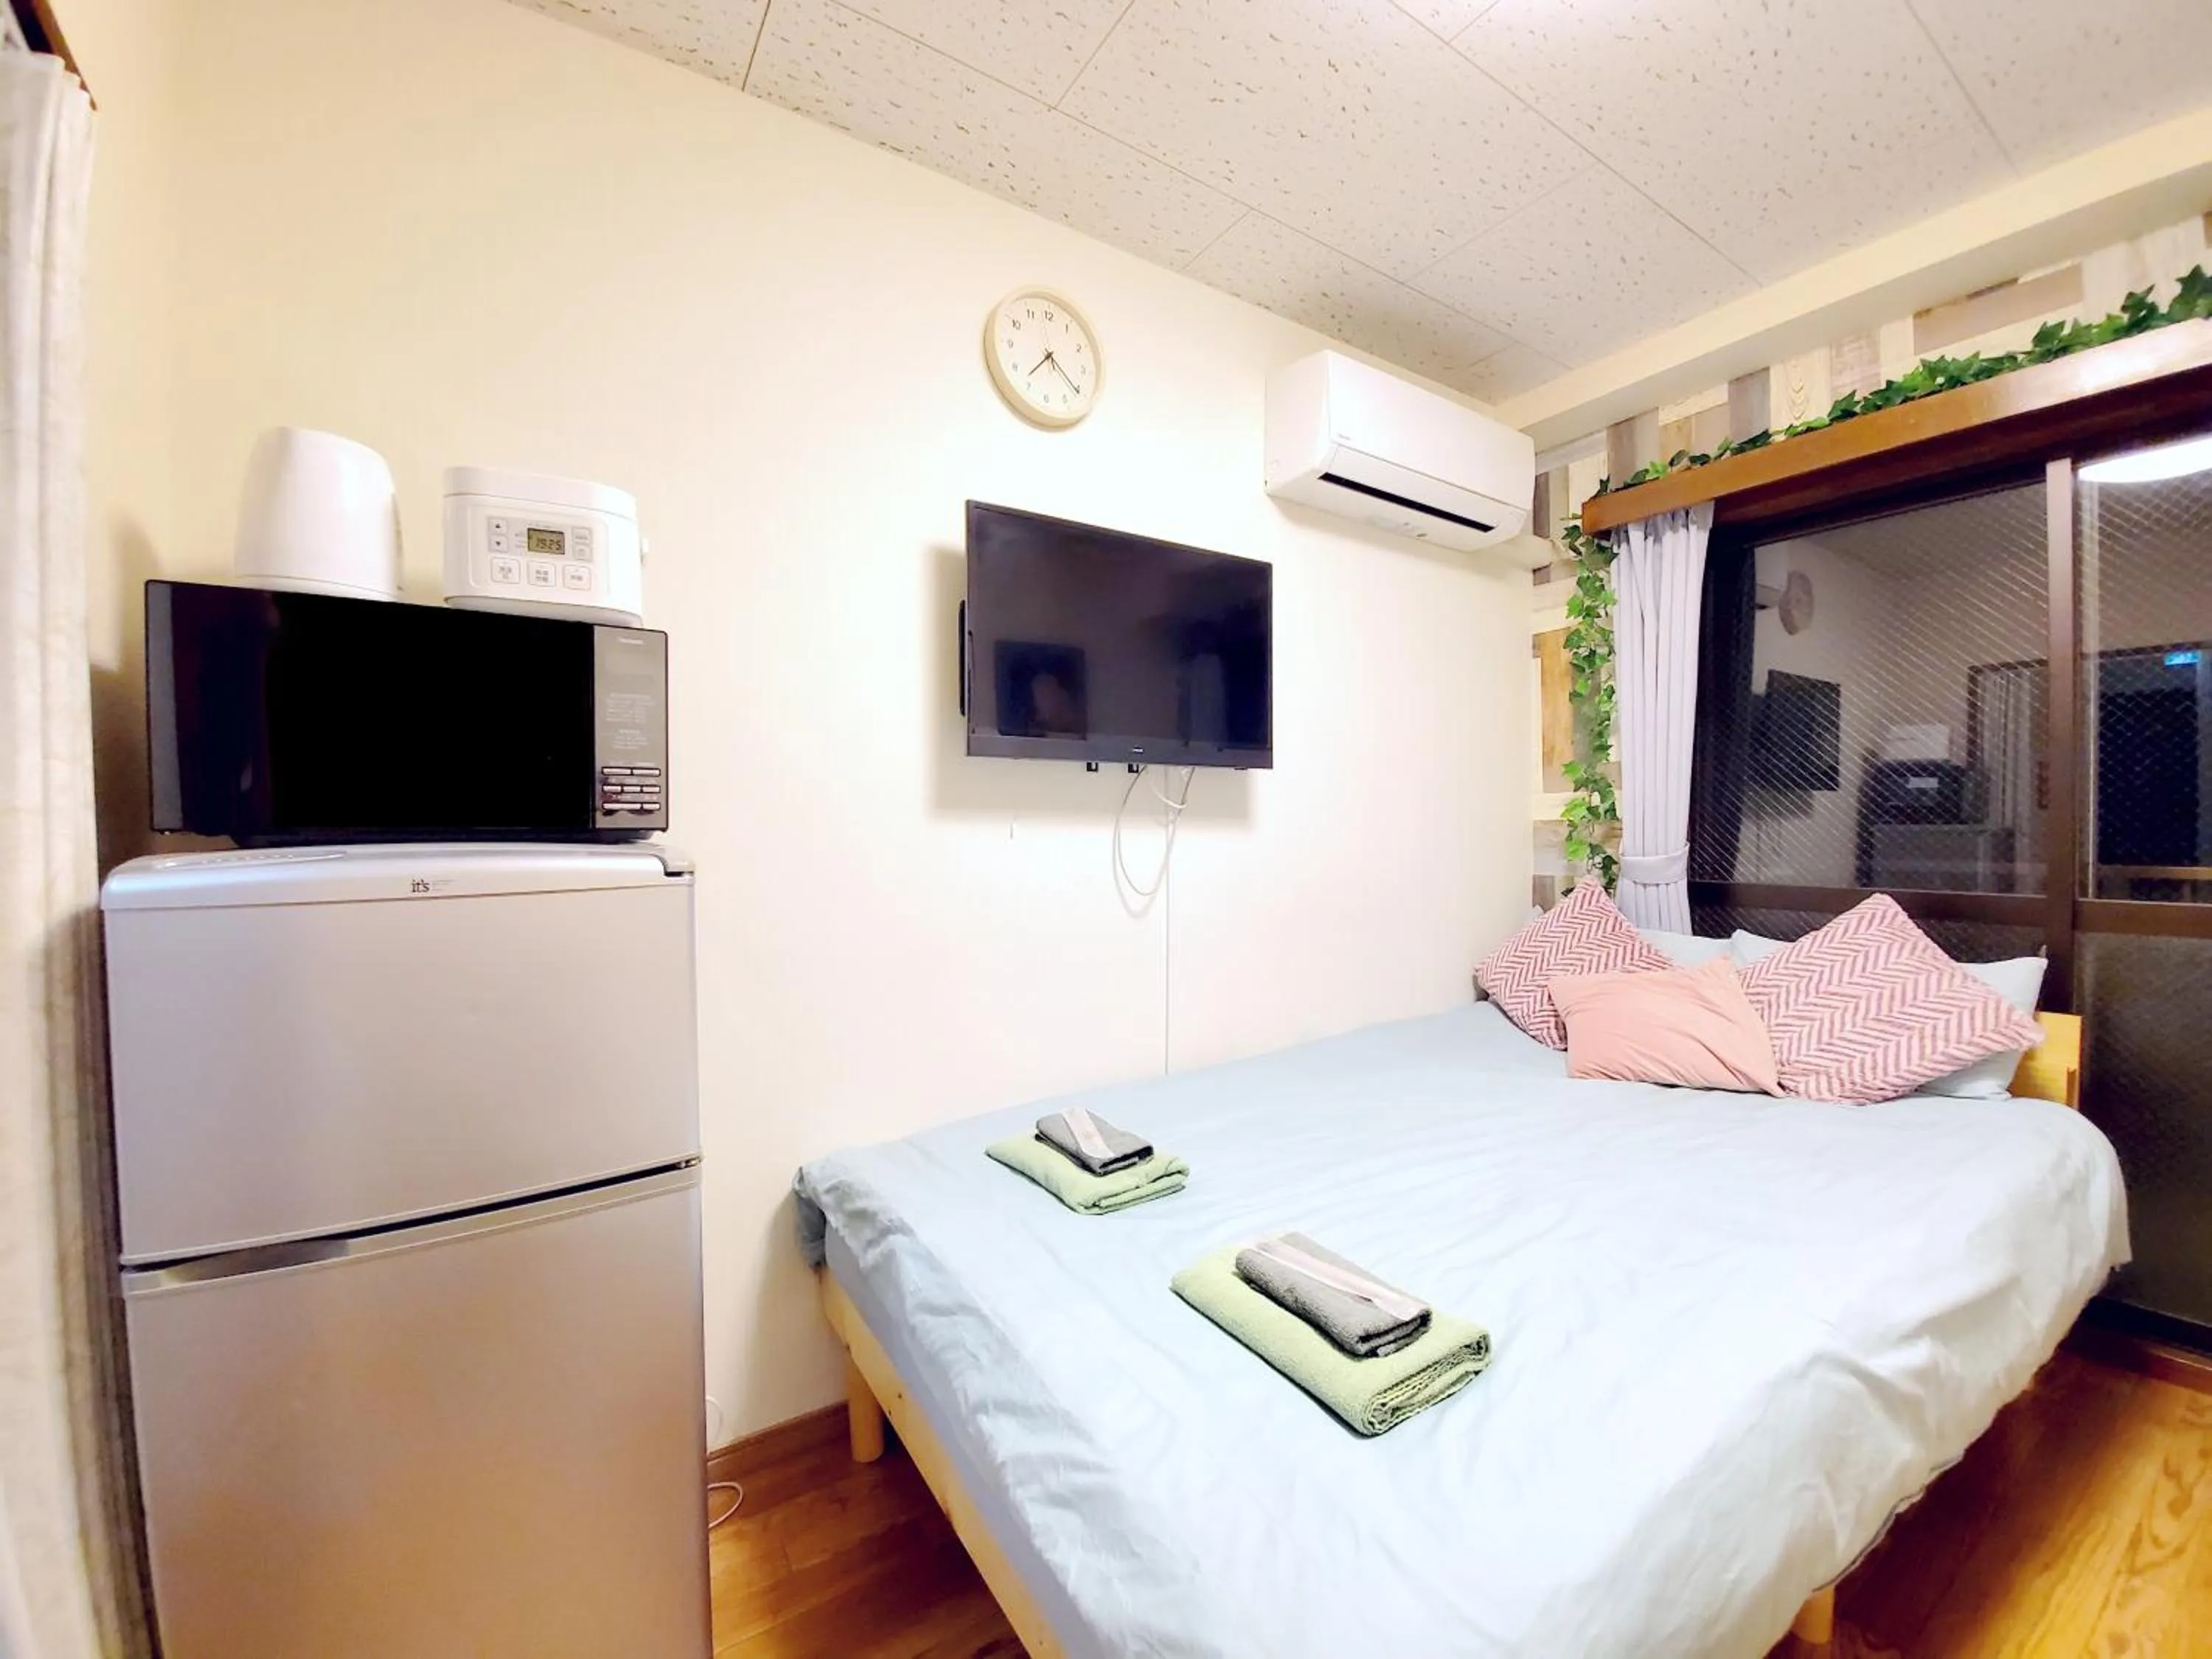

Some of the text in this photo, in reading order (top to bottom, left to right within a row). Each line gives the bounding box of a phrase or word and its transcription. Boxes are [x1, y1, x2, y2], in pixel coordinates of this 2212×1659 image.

[1026, 309, 1034, 319] 11
[1044, 310, 1054, 321] 12
[1012, 319, 1021, 330] 10
[1077, 344, 1082, 353] 2
[411, 879, 430, 893] it's
